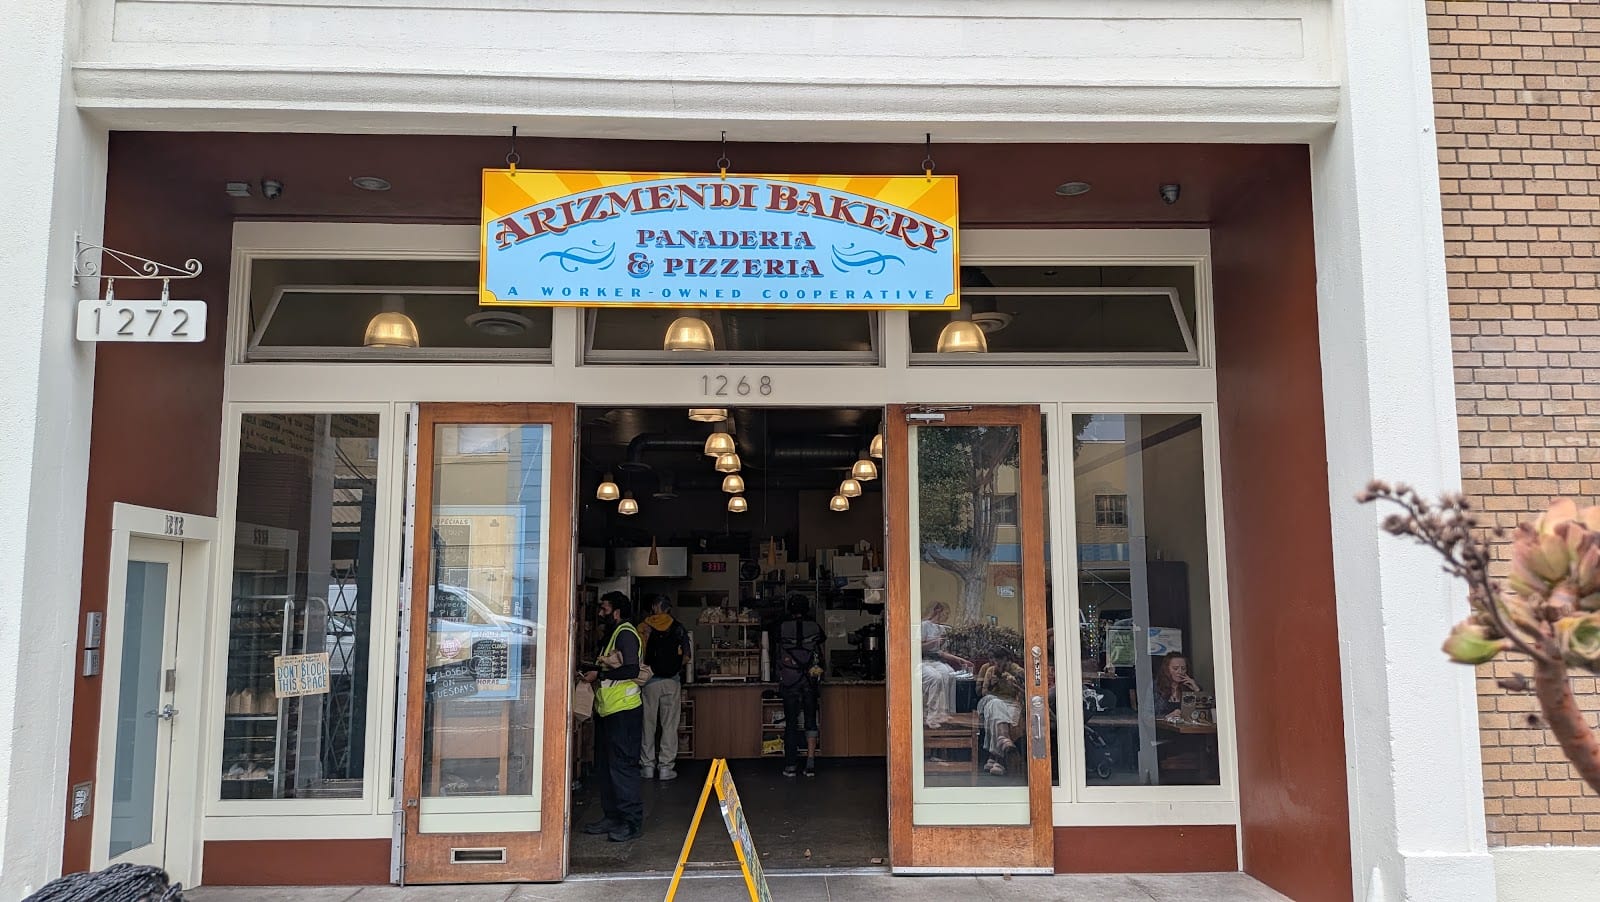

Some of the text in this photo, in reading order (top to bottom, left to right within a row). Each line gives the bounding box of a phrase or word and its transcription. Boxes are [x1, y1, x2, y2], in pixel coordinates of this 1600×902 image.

[494, 183, 950, 253] ARIZMENDI BAKERY
[636, 229, 816, 249] PANADERIA
[627, 252, 824, 278] & PIZZERIA
[507, 286, 934, 299] A WORKER-OWNED COOPERATIVE
[94, 307, 189, 336] 1272
[702, 375, 772, 396] 1268
[277, 674, 326, 692] THIS SPACE
